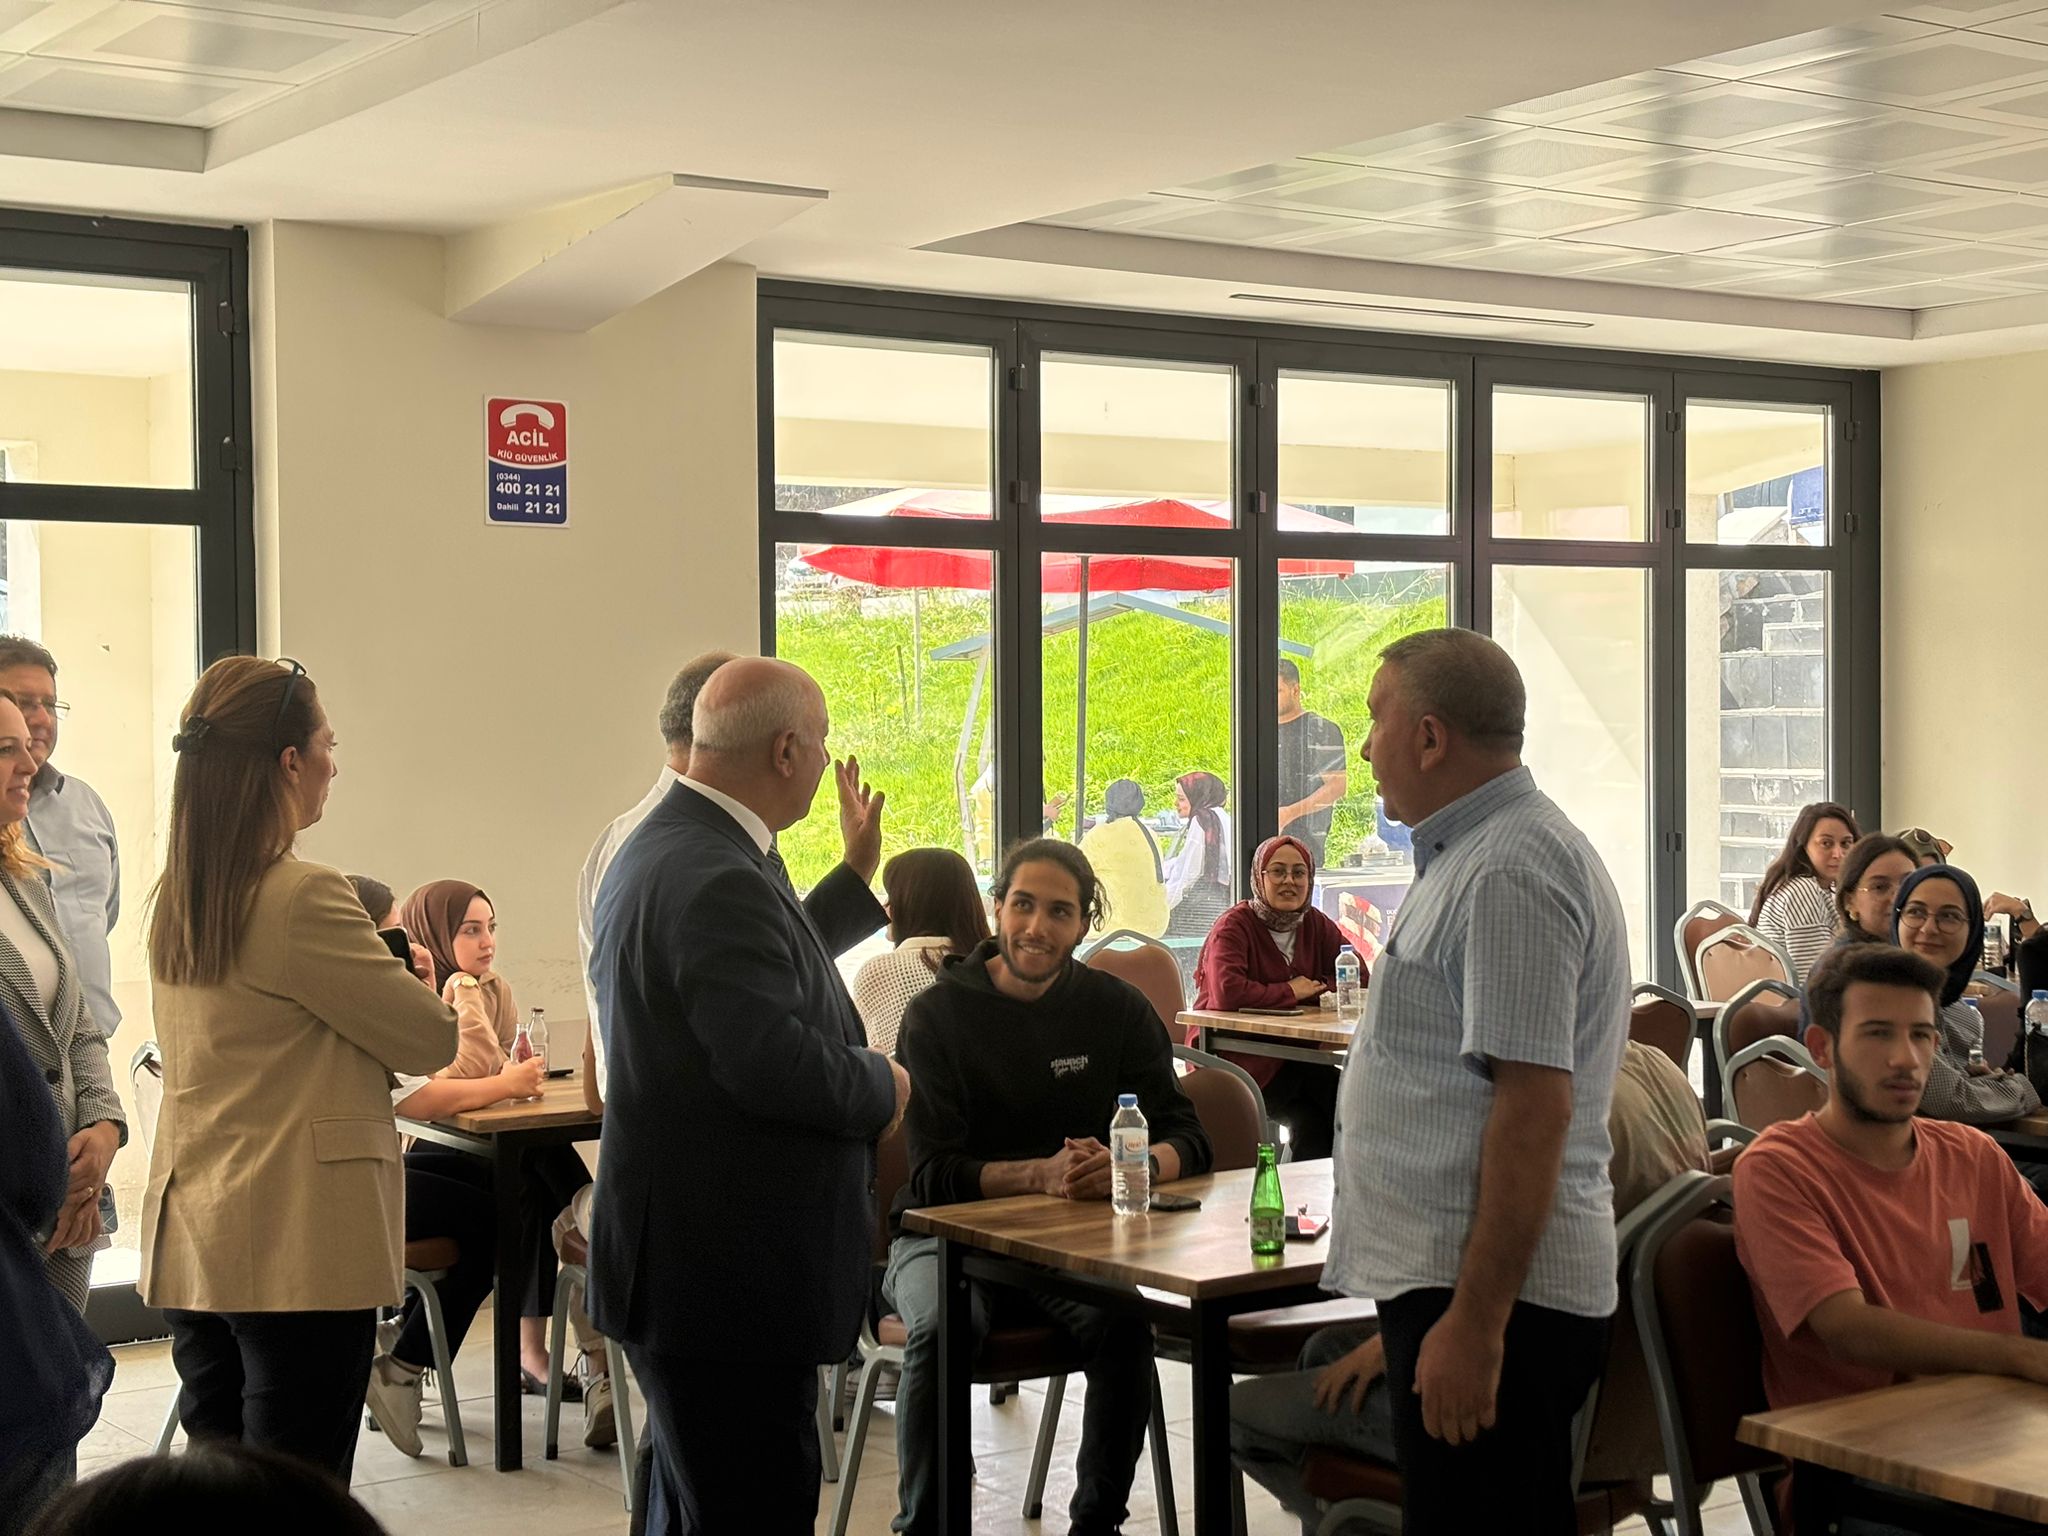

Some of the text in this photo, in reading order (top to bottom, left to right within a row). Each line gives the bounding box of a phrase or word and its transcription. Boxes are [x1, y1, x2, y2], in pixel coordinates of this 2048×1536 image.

[506, 428, 549, 447] ACİL
[514, 452, 559, 463] GÜVENLİK
[496, 472, 521, 482] (0344)
[496, 482, 560, 497] 400 21 21
[496, 501, 560, 515] Dahili 21 21
